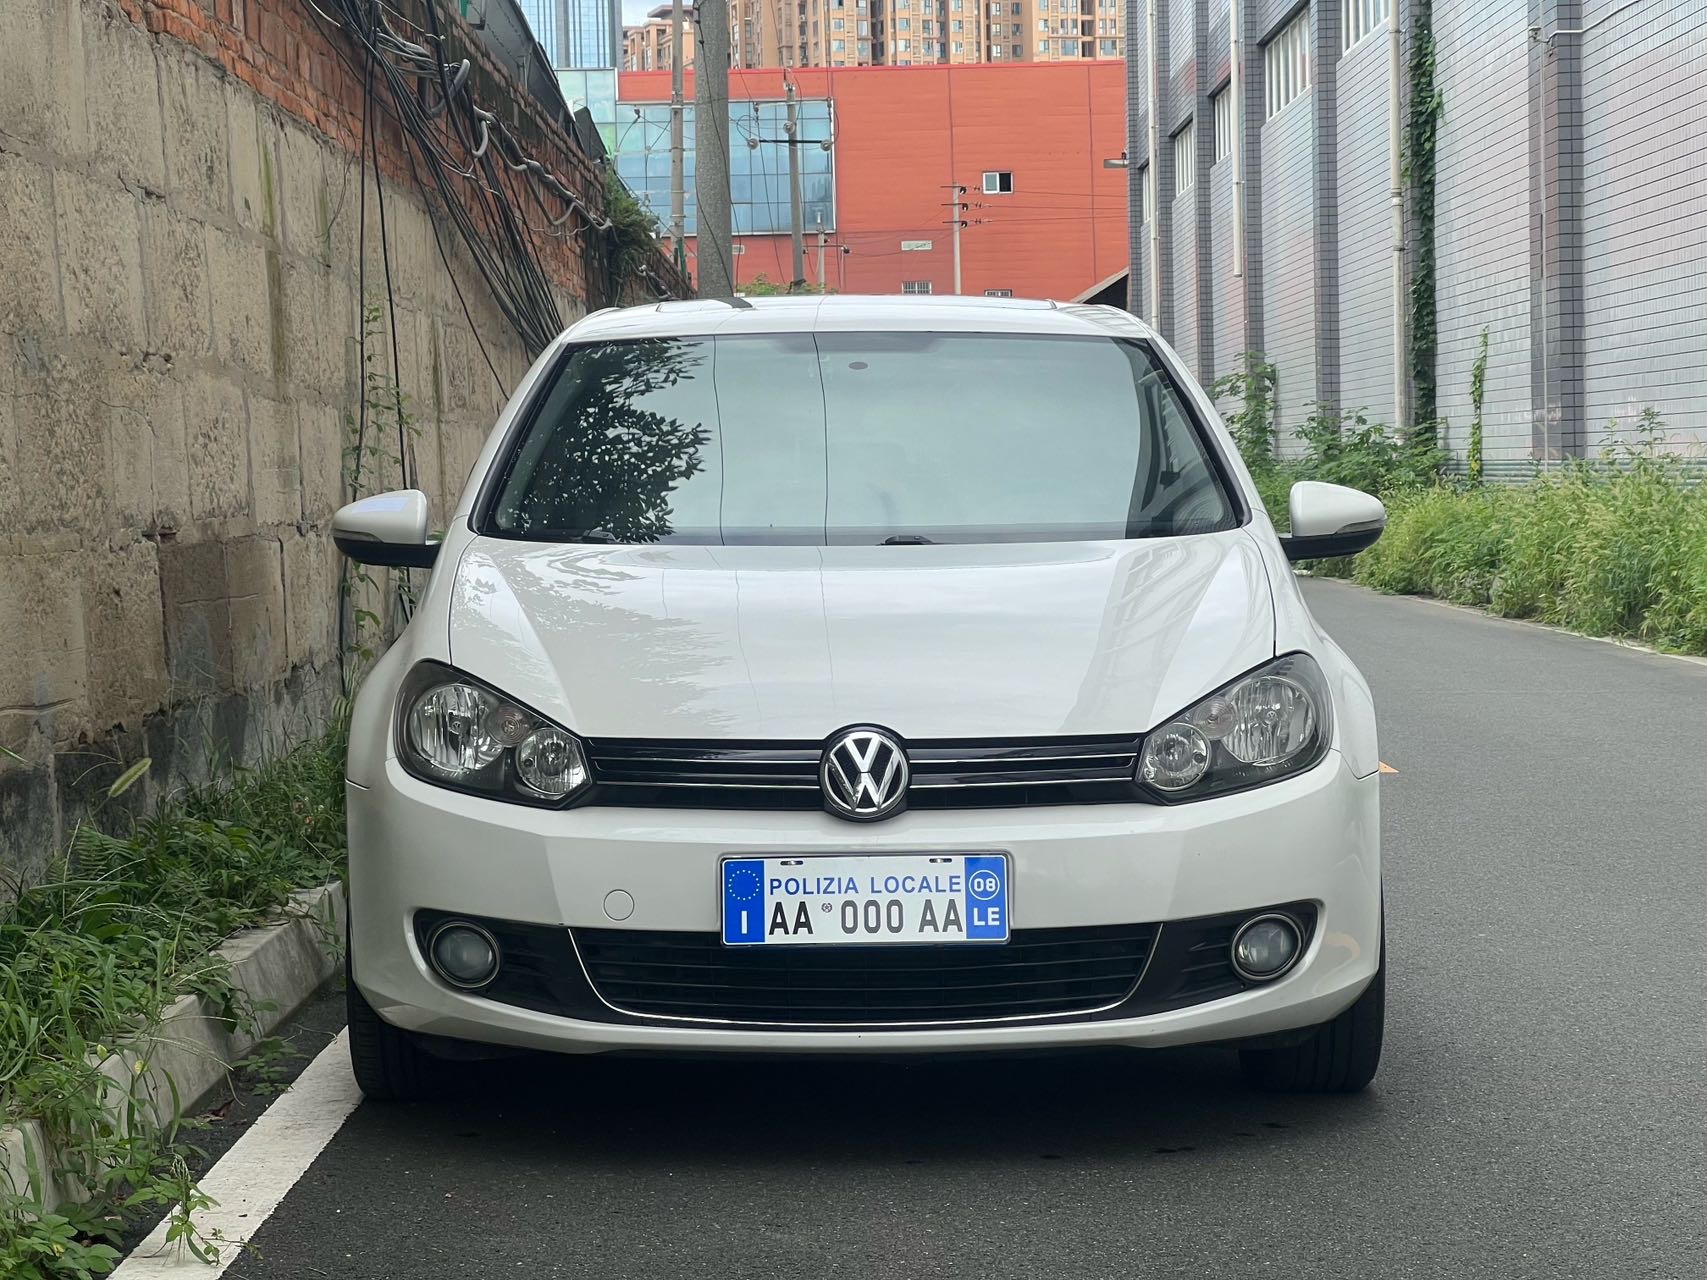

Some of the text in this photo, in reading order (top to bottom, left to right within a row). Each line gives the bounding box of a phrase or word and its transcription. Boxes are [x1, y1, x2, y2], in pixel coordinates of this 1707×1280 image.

[823, 729, 908, 816] VW
[769, 875, 961, 895] POLIZIA LOCALE
[973, 878, 997, 892] 08
[768, 898, 963, 935] AA 000 AA
[973, 907, 1000, 926] LE
